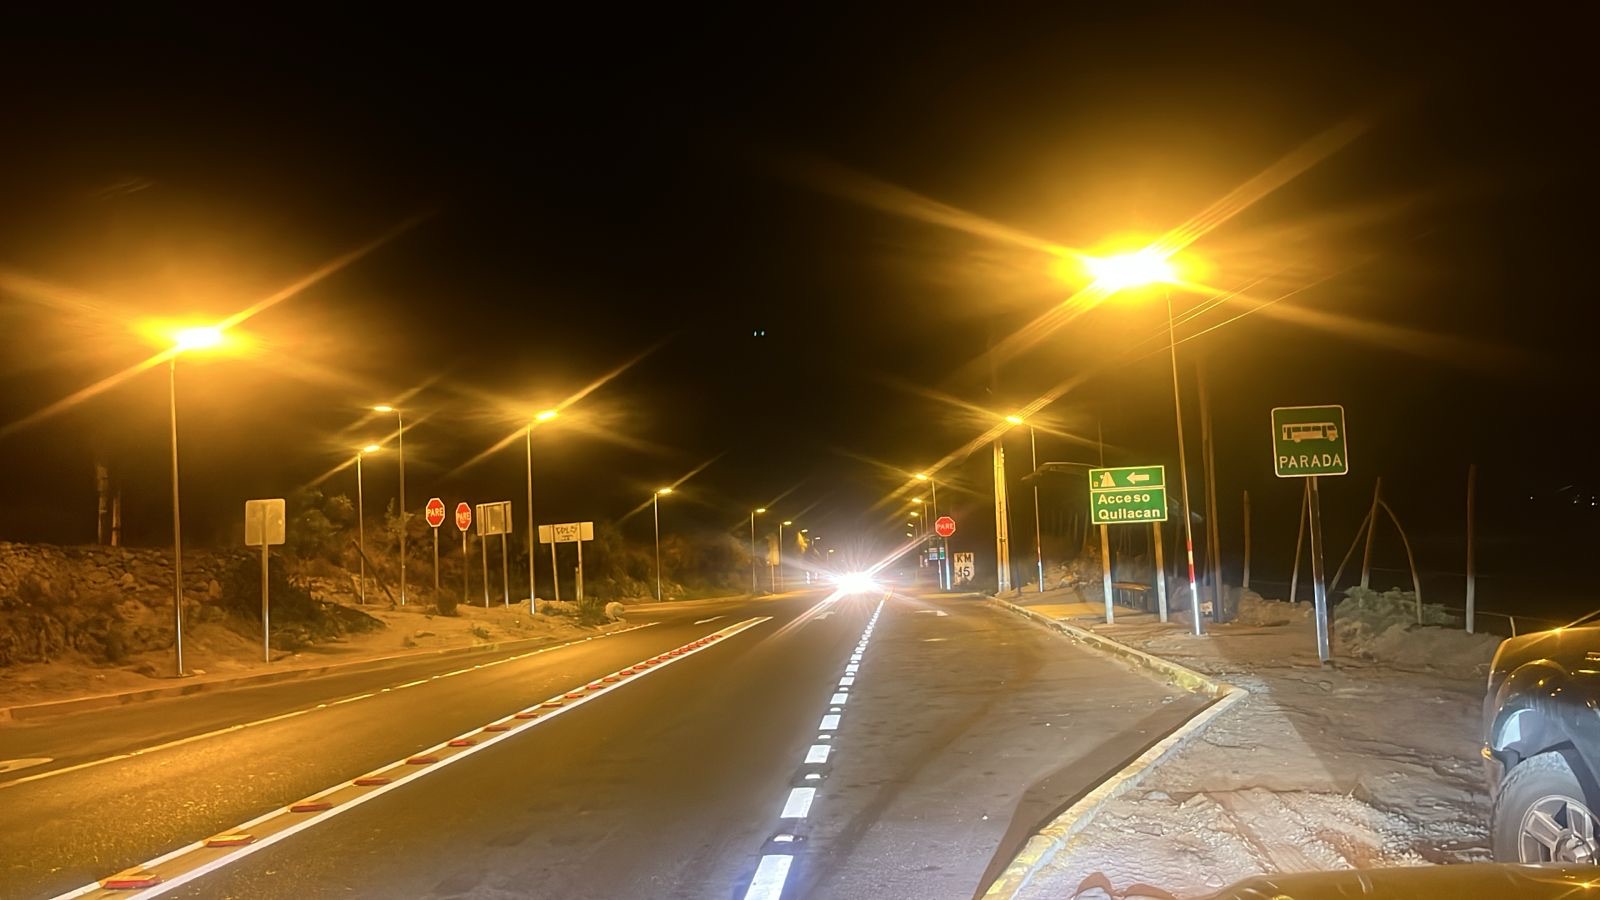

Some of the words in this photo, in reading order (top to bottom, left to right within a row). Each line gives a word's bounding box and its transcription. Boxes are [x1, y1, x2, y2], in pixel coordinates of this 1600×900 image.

[1280, 454, 1342, 469] PARADA
[1098, 494, 1150, 504] Acceso
[427, 507, 444, 517] PARE
[937, 523, 954, 531] PARE
[956, 553, 972, 563] KM
